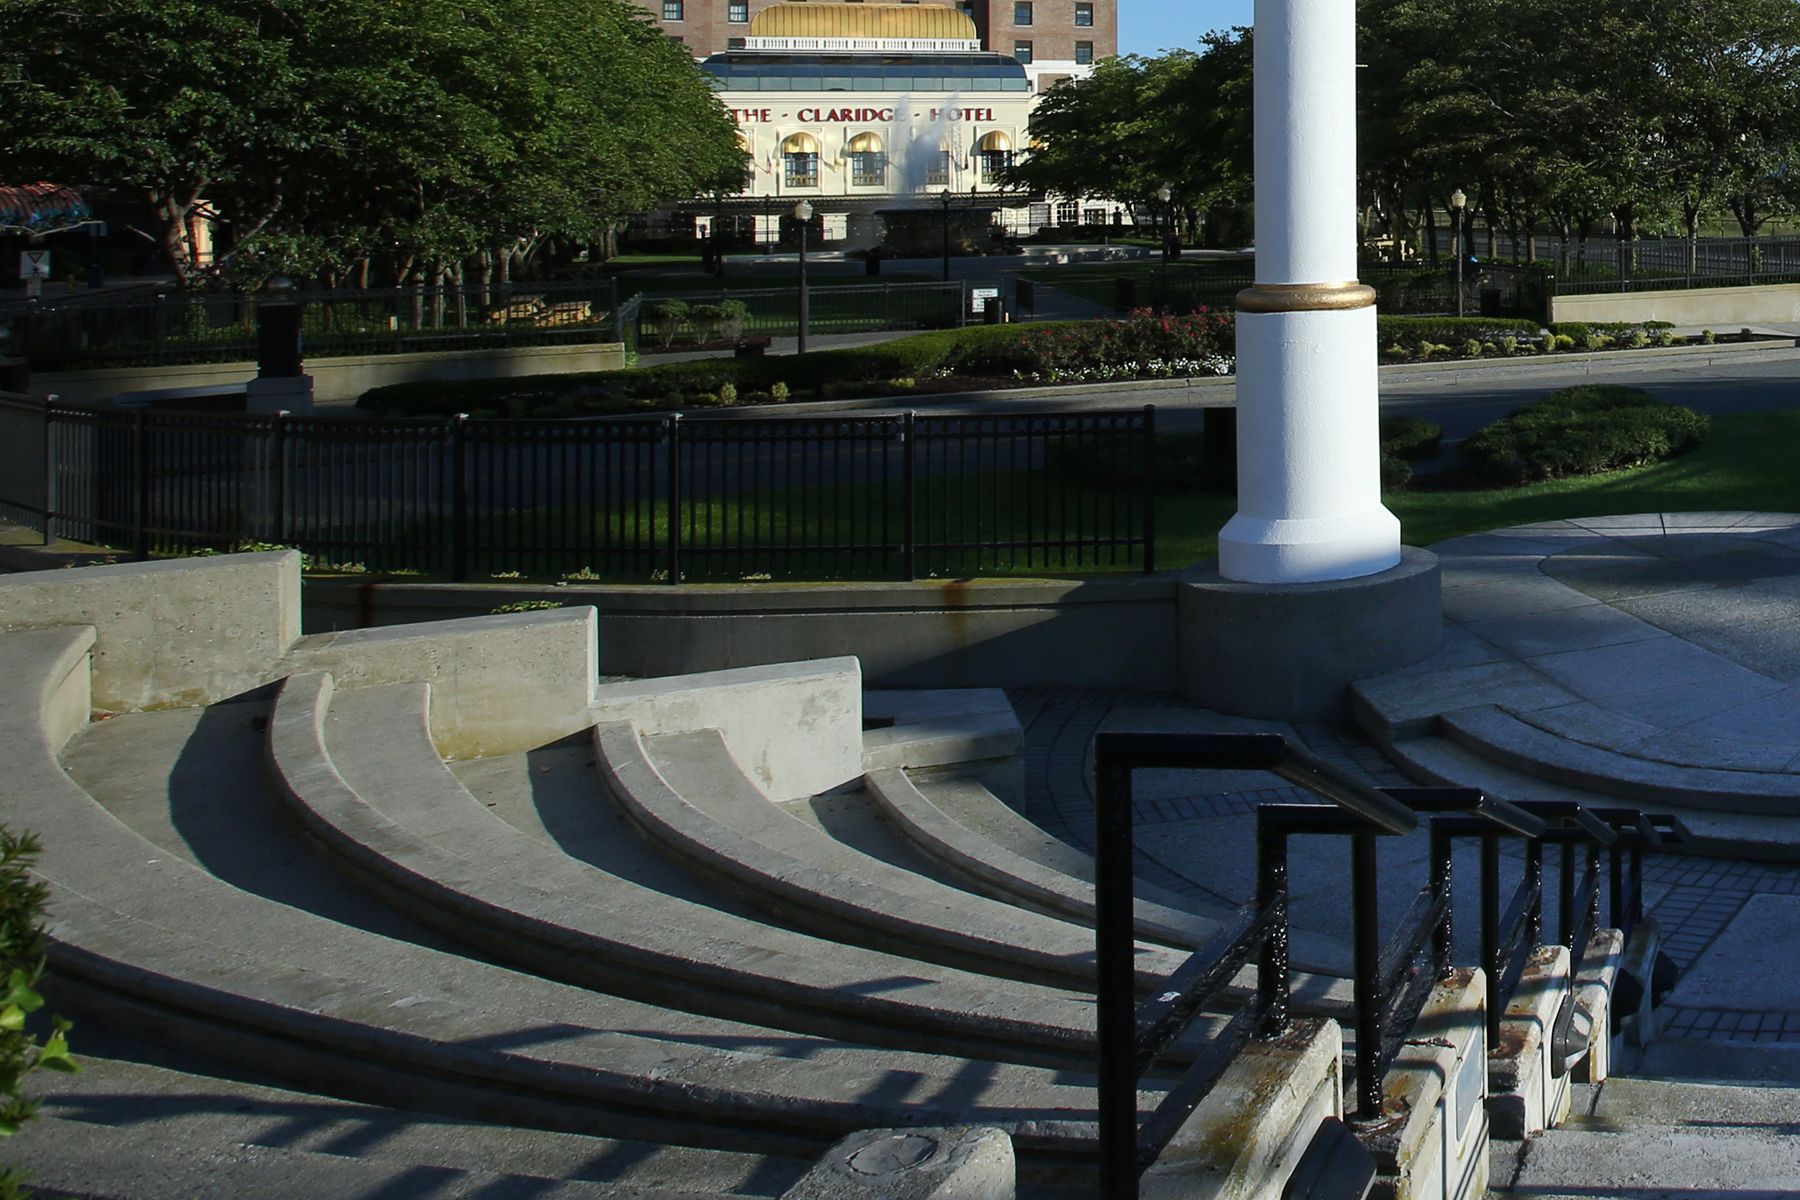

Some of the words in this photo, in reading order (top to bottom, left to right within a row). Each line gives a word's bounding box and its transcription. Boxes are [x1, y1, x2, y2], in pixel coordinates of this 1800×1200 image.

[729, 108, 772, 123] THE
[796, 107, 907, 123] CLARIDGE
[928, 107, 998, 122] HOTEL
